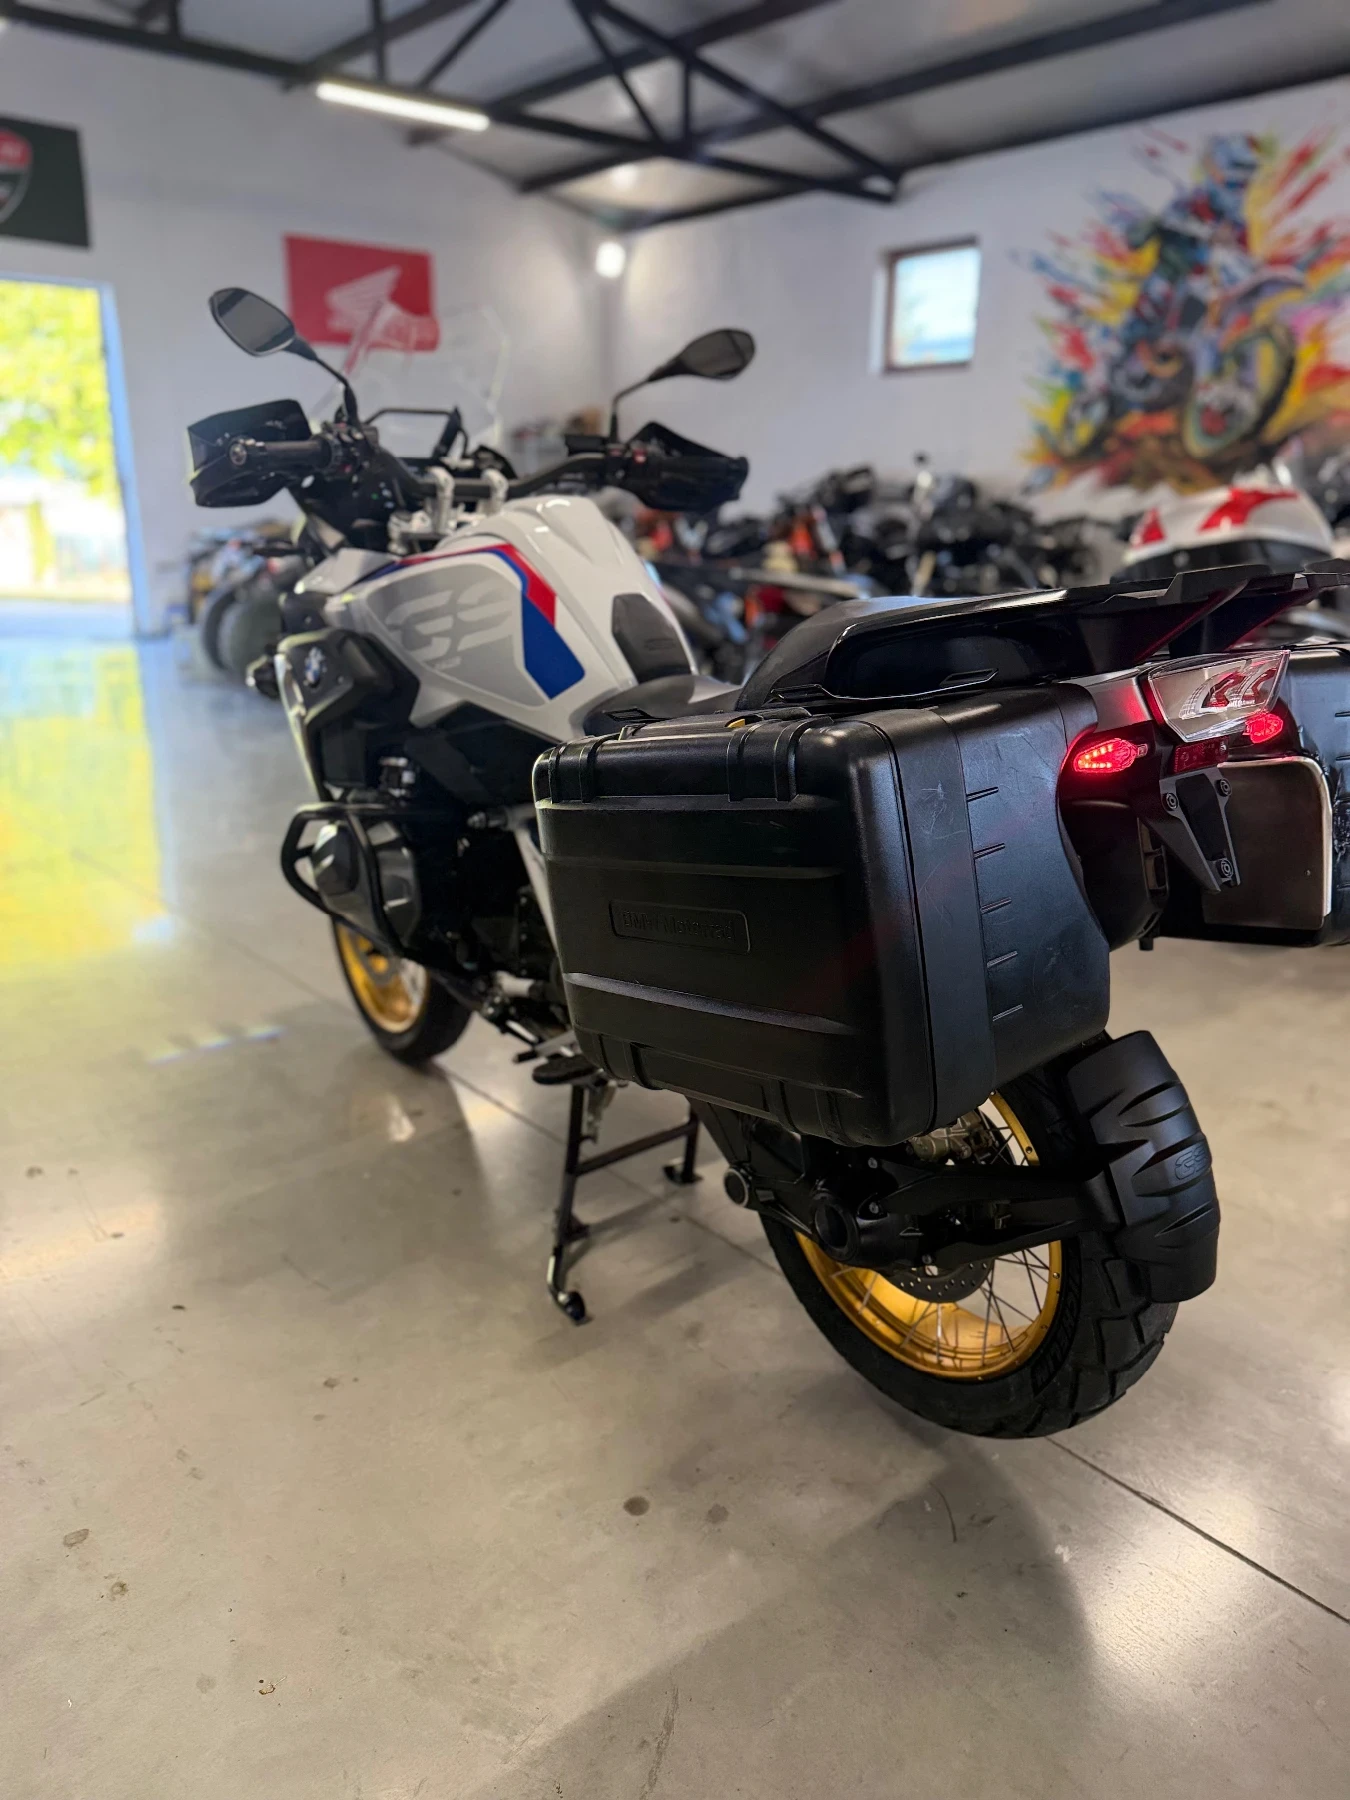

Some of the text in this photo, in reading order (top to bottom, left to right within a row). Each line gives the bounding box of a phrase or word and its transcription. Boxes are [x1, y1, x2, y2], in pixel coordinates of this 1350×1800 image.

[384, 578, 515, 662] GS
[623, 911, 737, 943] BMW Motorrad
[1174, 1143, 1208, 1180] GS
